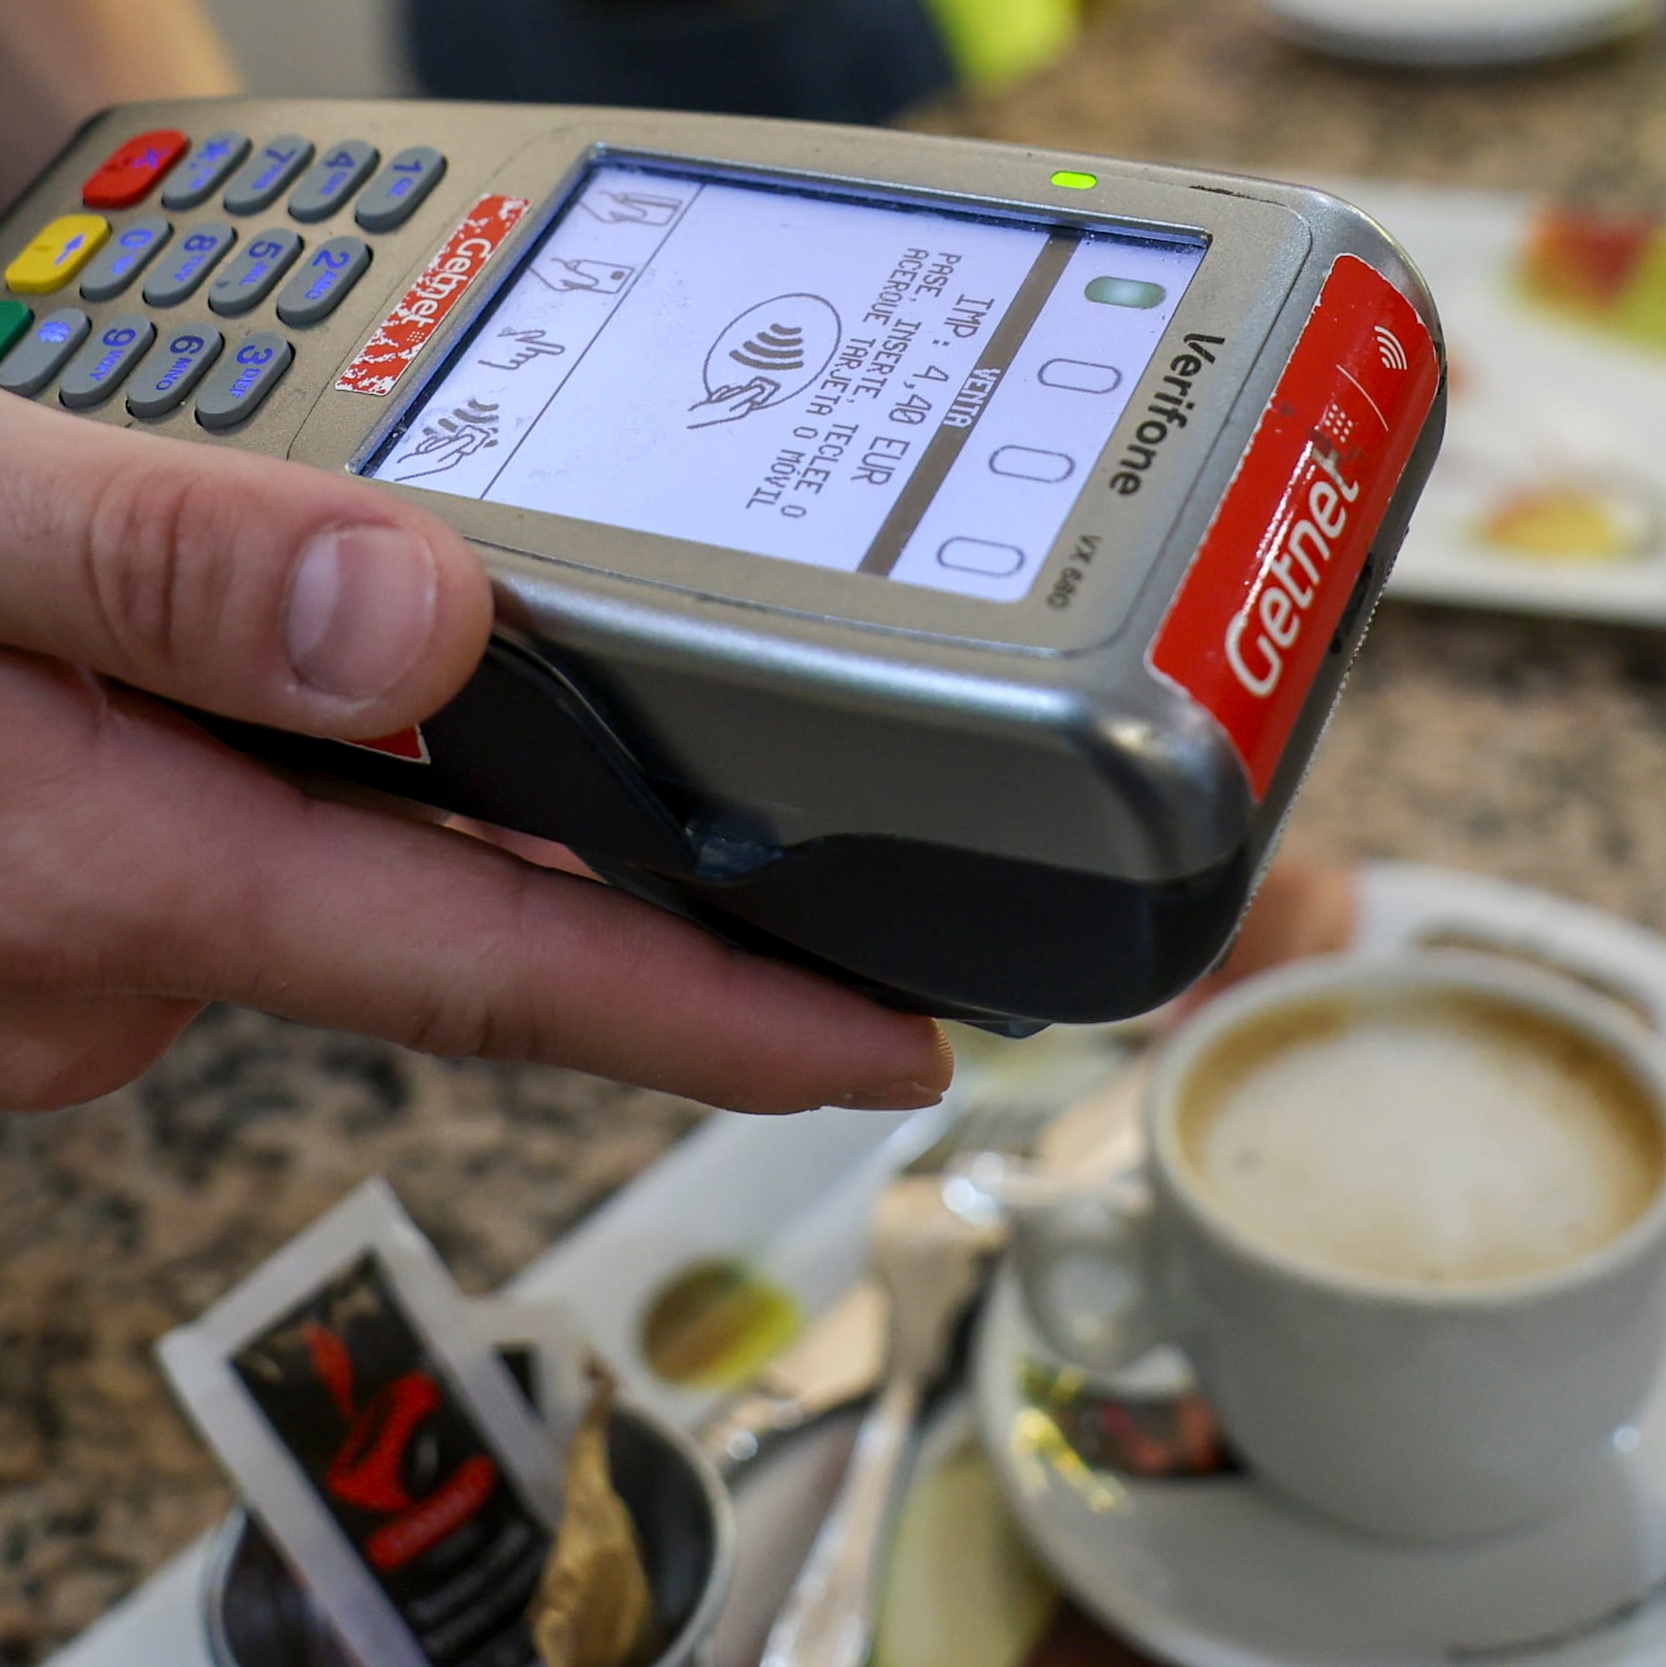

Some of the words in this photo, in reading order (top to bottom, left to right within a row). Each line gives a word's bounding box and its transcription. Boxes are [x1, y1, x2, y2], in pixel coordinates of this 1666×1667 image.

[325, 151, 356, 169] 4
[393, 159, 422, 174] 1
[120, 229, 154, 248] 0
[184, 234, 218, 253] 8
[249, 240, 283, 260] 5
[312, 249, 350, 270] 2
[402, 238, 492, 326] Getnet
[910, 252, 962, 302] PASE,
[103, 328, 137, 347] 9
[170, 334, 204, 355] 6
[236, 345, 273, 366] 3
[845, 318, 922, 404] INSERTE,
[155, 357, 193, 392] MNO
[229, 368, 261, 399] DEF
[806, 338, 876, 416] TARJETA
[889, 365, 949, 425] 4,40
[941, 367, 1001, 428] VENTA
[1109, 333, 1225, 496] Verifone
[793, 426, 818, 439] O
[794, 423, 859, 494] TECLEE
[851, 436, 911, 485] EUR
[780, 504, 807, 518] O
[1069, 534, 1103, 565] VX
[1046, 566, 1083, 610] 680
[1225, 447, 1359, 699] Getnet
